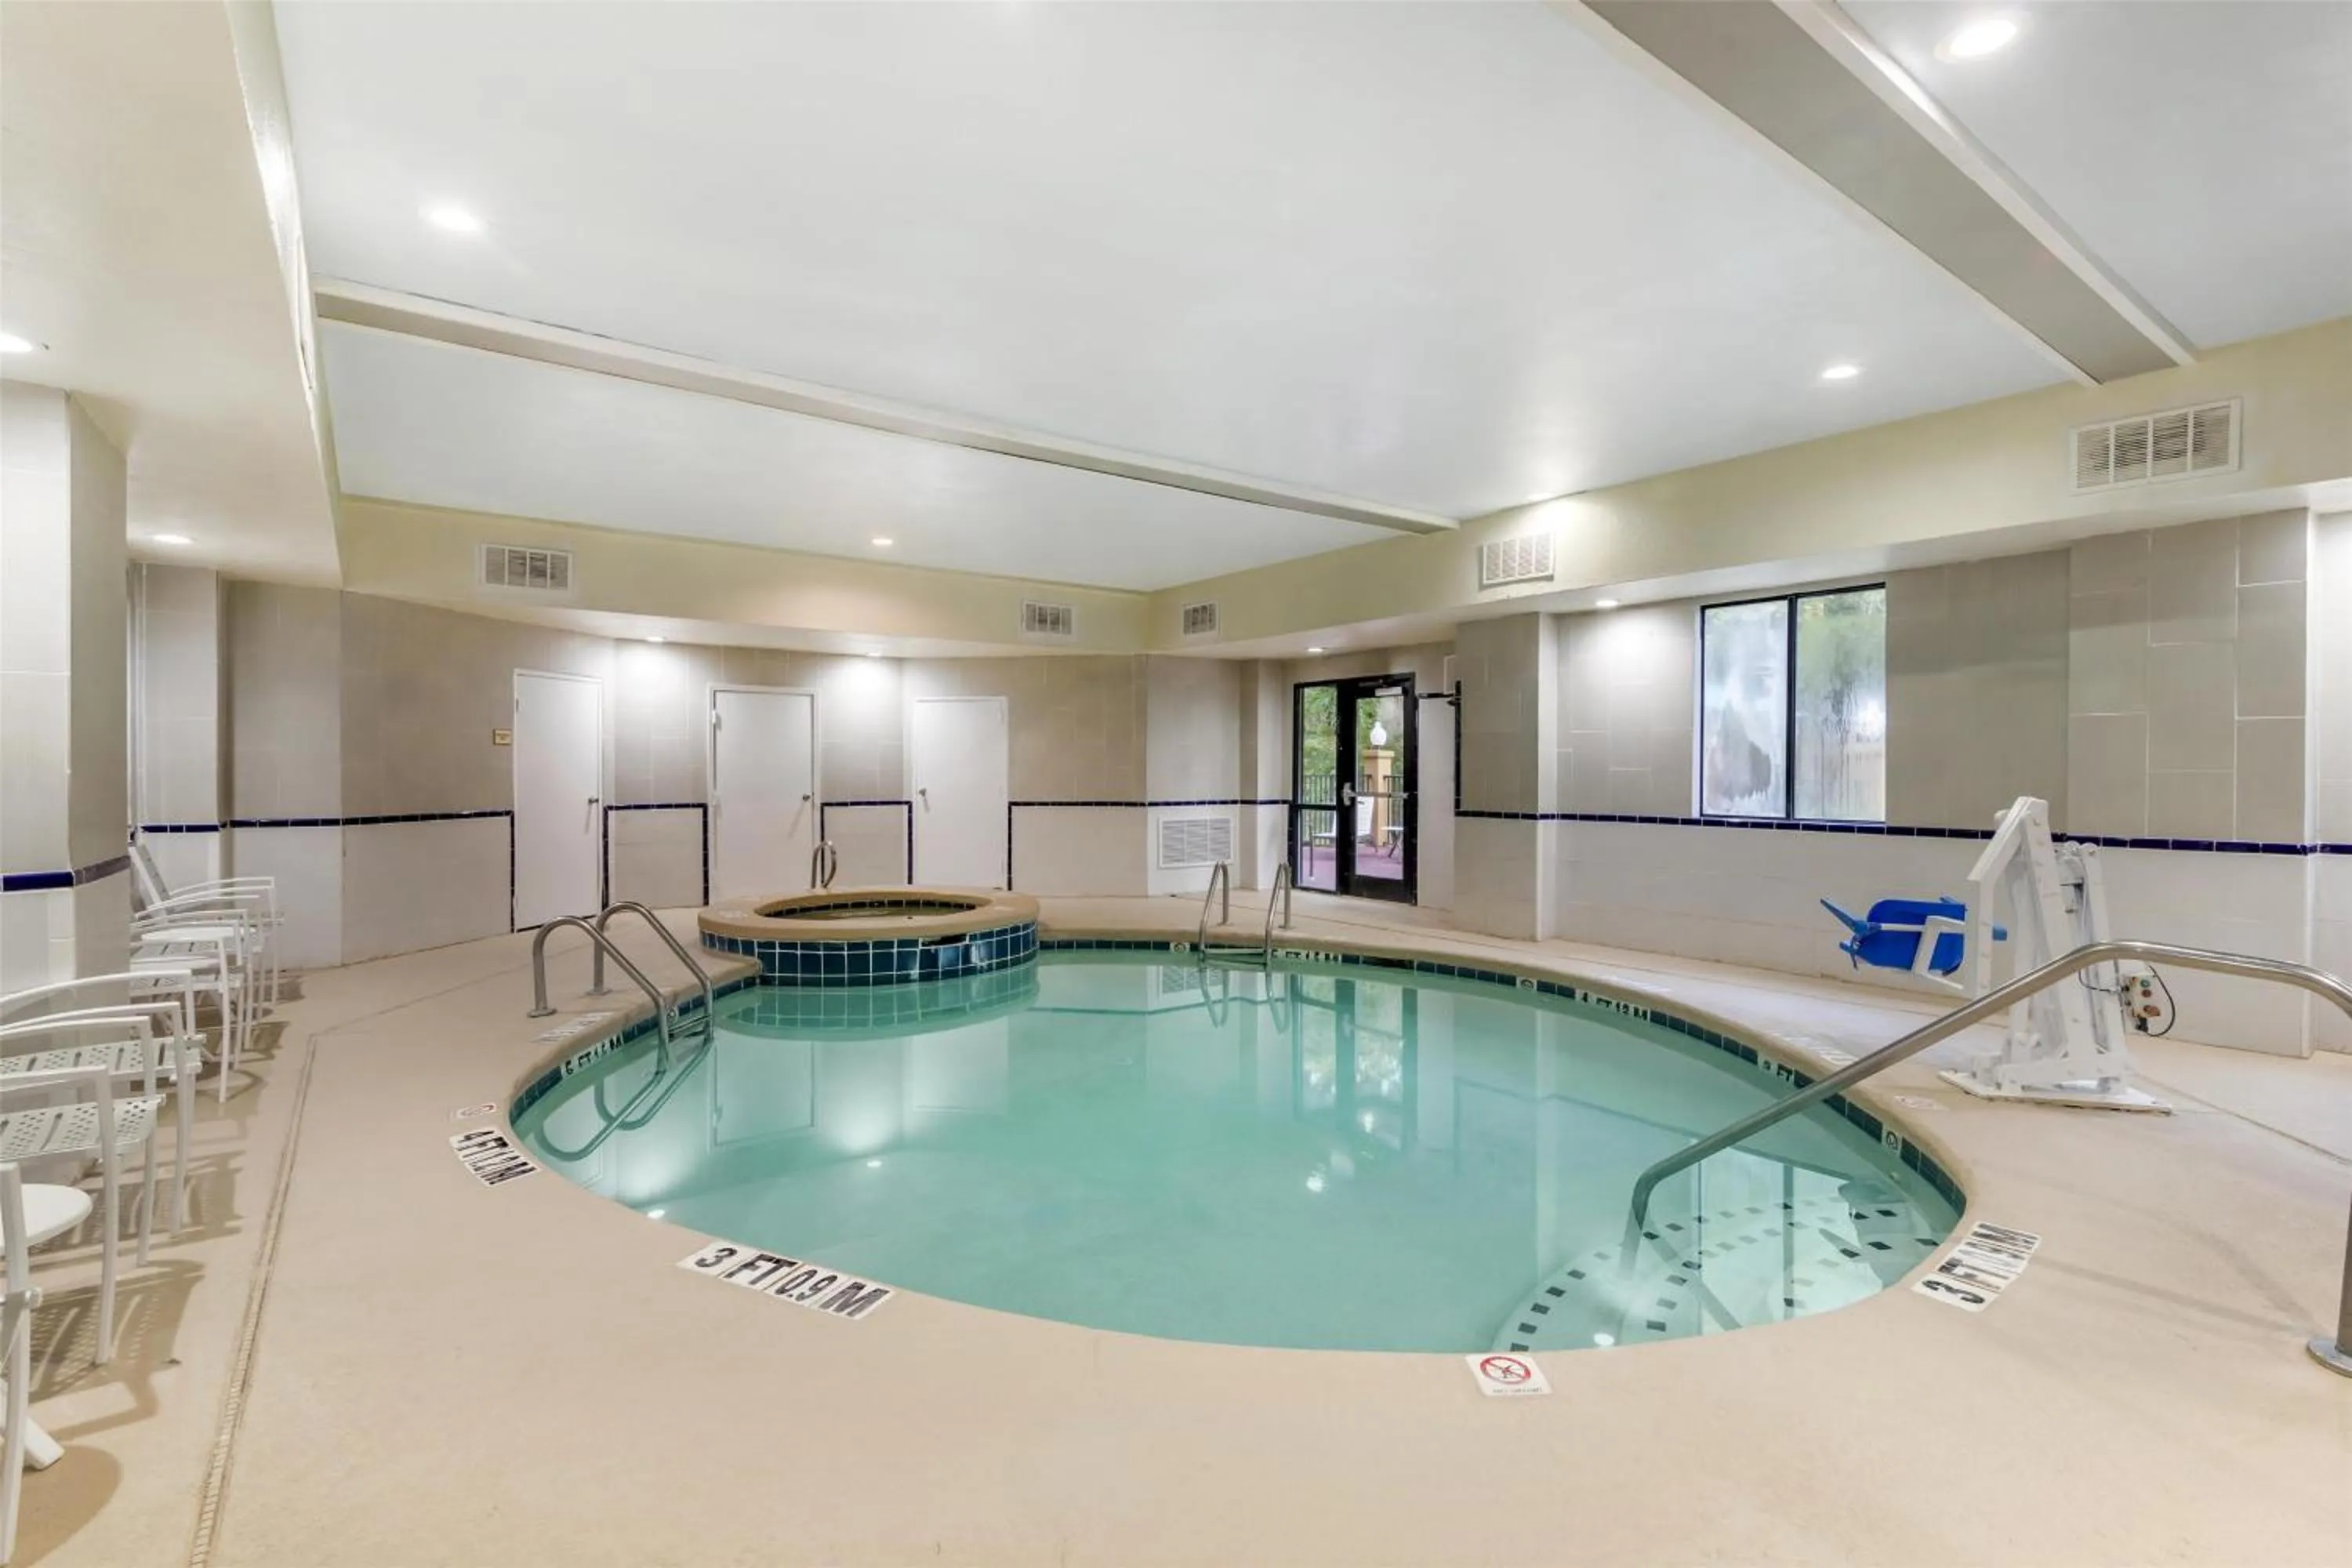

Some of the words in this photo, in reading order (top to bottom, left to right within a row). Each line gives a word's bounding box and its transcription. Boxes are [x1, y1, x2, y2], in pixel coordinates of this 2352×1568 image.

[456, 1135, 509, 1159] FT
[479, 1160, 537, 1185] M
[1970, 1222, 2040, 1251] M
[695, 1247, 738, 1269] 3
[723, 1253, 798, 1286] FT
[774, 1269, 839, 1302] 0.9
[818, 1281, 891, 1318] M
[1936, 1257, 2010, 1290] FT
[1922, 1279, 1986, 1305] 3
